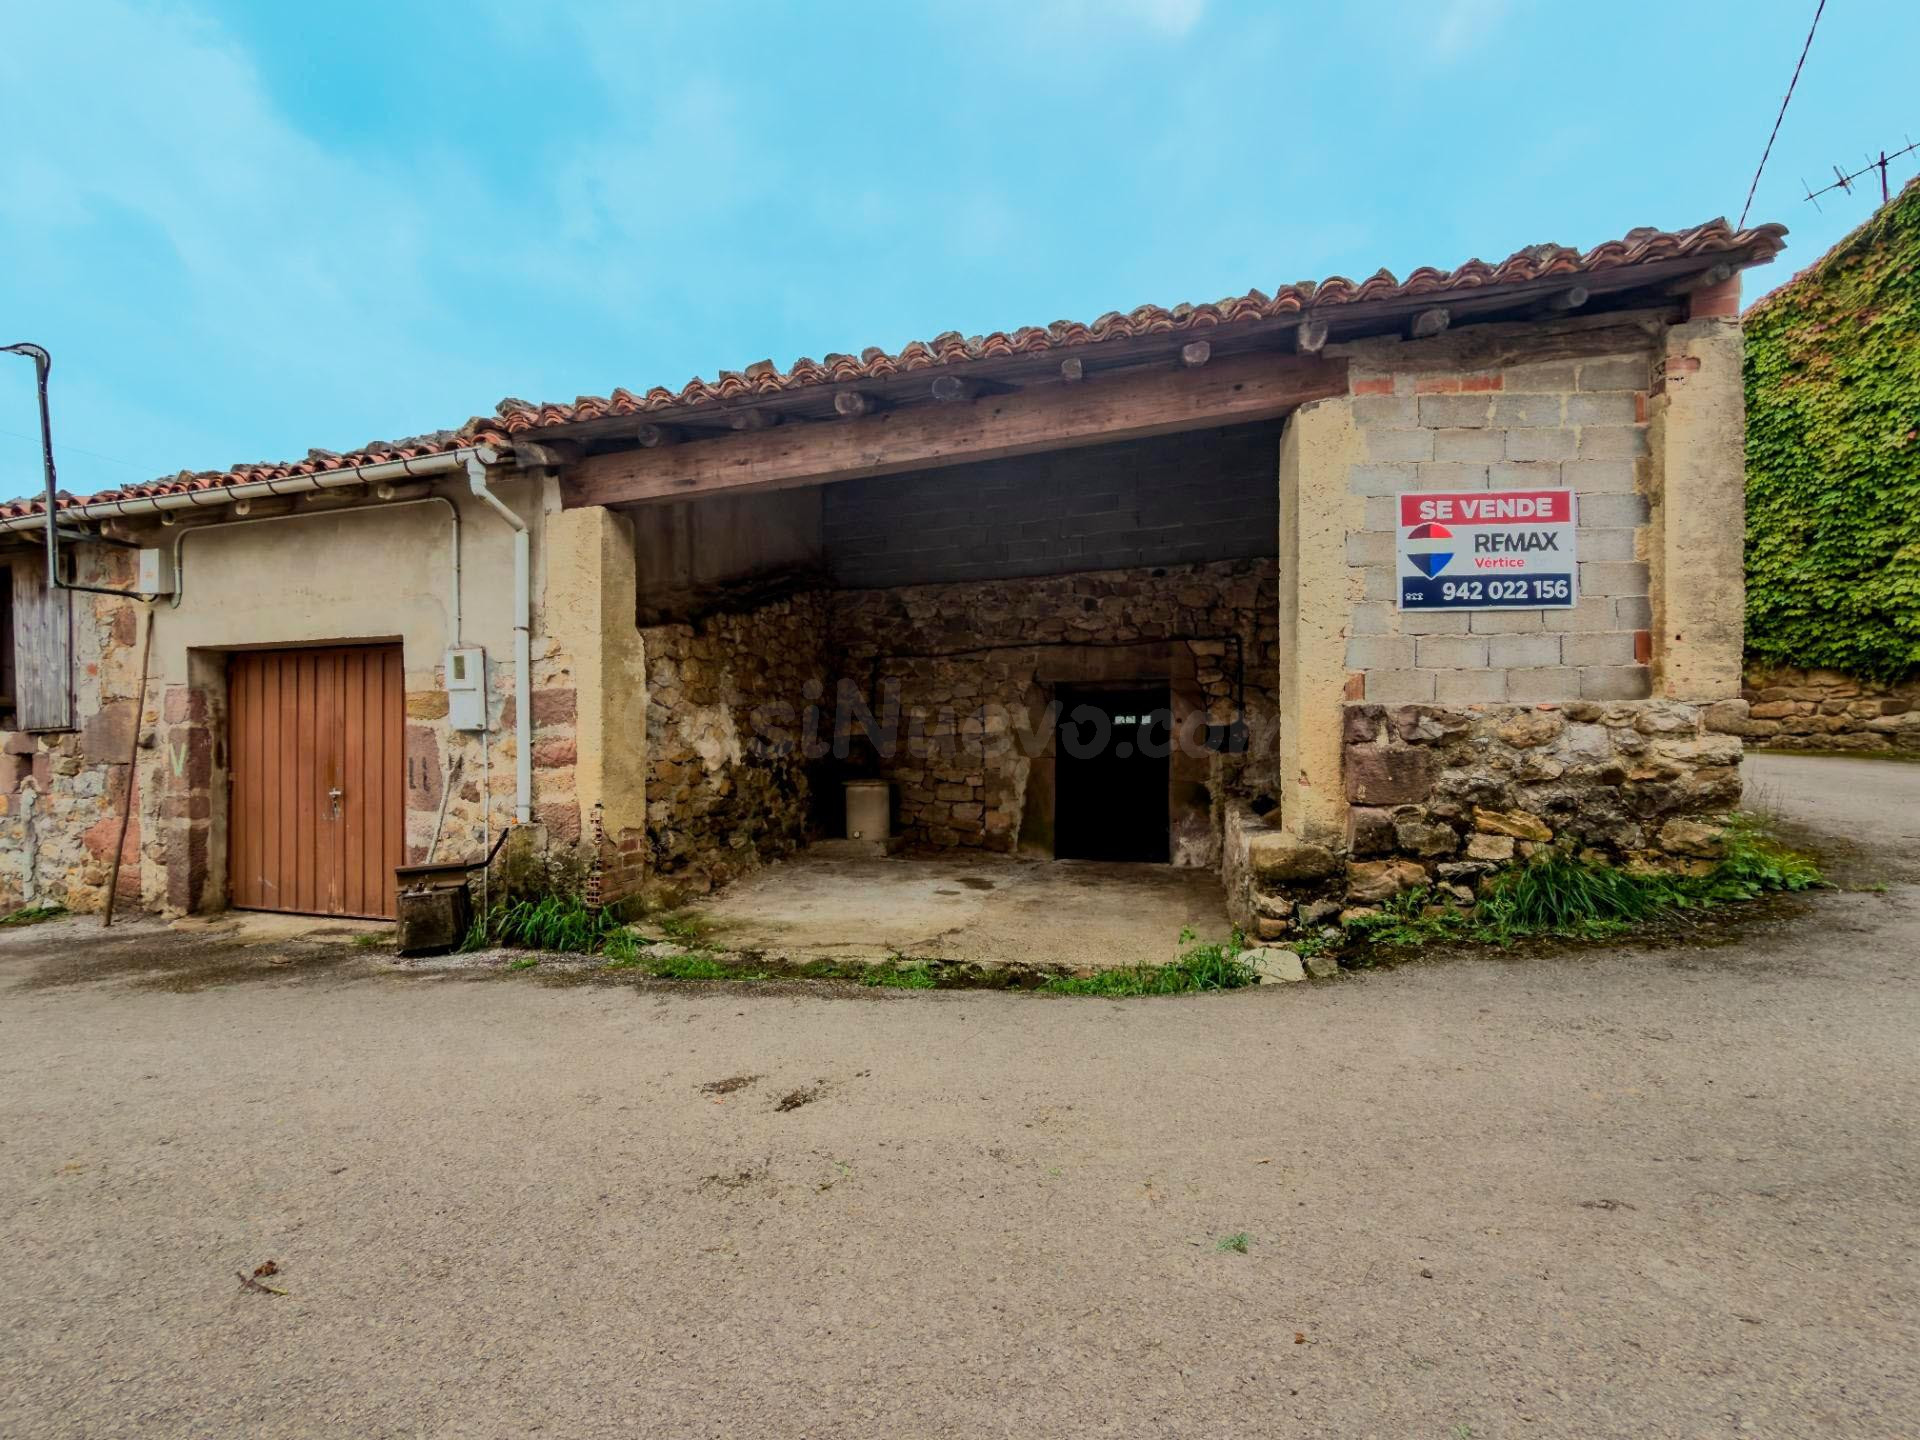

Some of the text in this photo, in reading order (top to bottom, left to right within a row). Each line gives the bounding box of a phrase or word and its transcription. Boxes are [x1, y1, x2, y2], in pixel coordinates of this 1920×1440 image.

[1419, 498, 1553, 520] SE VENDE
[1474, 532, 1559, 553] REMAX
[1474, 556, 1525, 569] Vértice
[1442, 582, 1483, 601] 942
[1487, 580, 1529, 600] 022
[1532, 580, 1568, 599] 156
